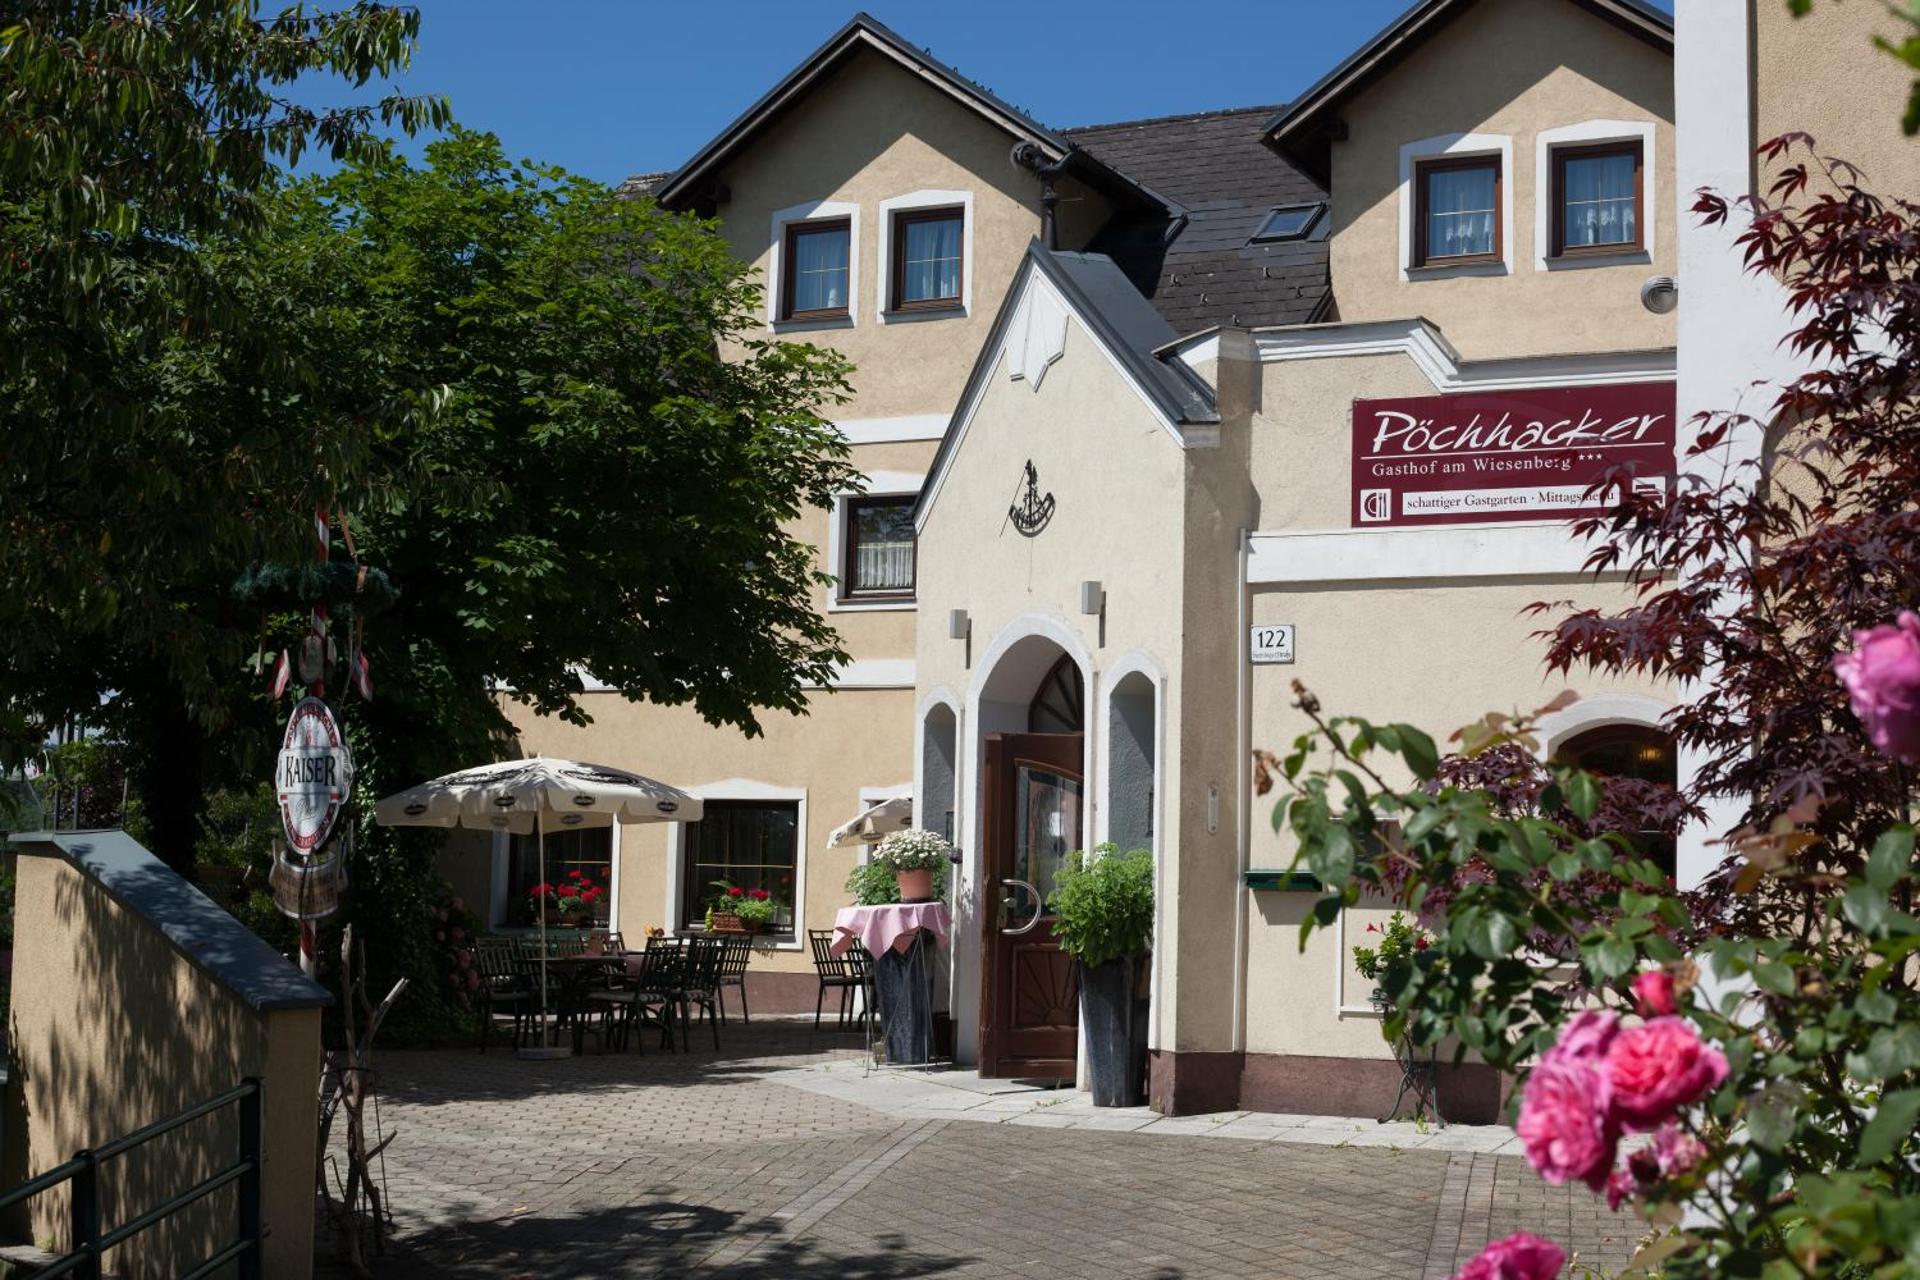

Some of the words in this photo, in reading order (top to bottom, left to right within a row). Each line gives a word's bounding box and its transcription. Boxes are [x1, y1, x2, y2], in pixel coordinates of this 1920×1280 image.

[1372, 408, 1666, 454] Pöchhacker
[1372, 460, 1438, 477] Gasthof
[1443, 462, 1465, 474] am
[1473, 455, 1571, 471] Wiesenberg
[1407, 496, 1461, 509] schattiger
[1464, 494, 1527, 508] Gastgarten
[1257, 629, 1286, 648] 122
[285, 755, 336, 787] KAISER
